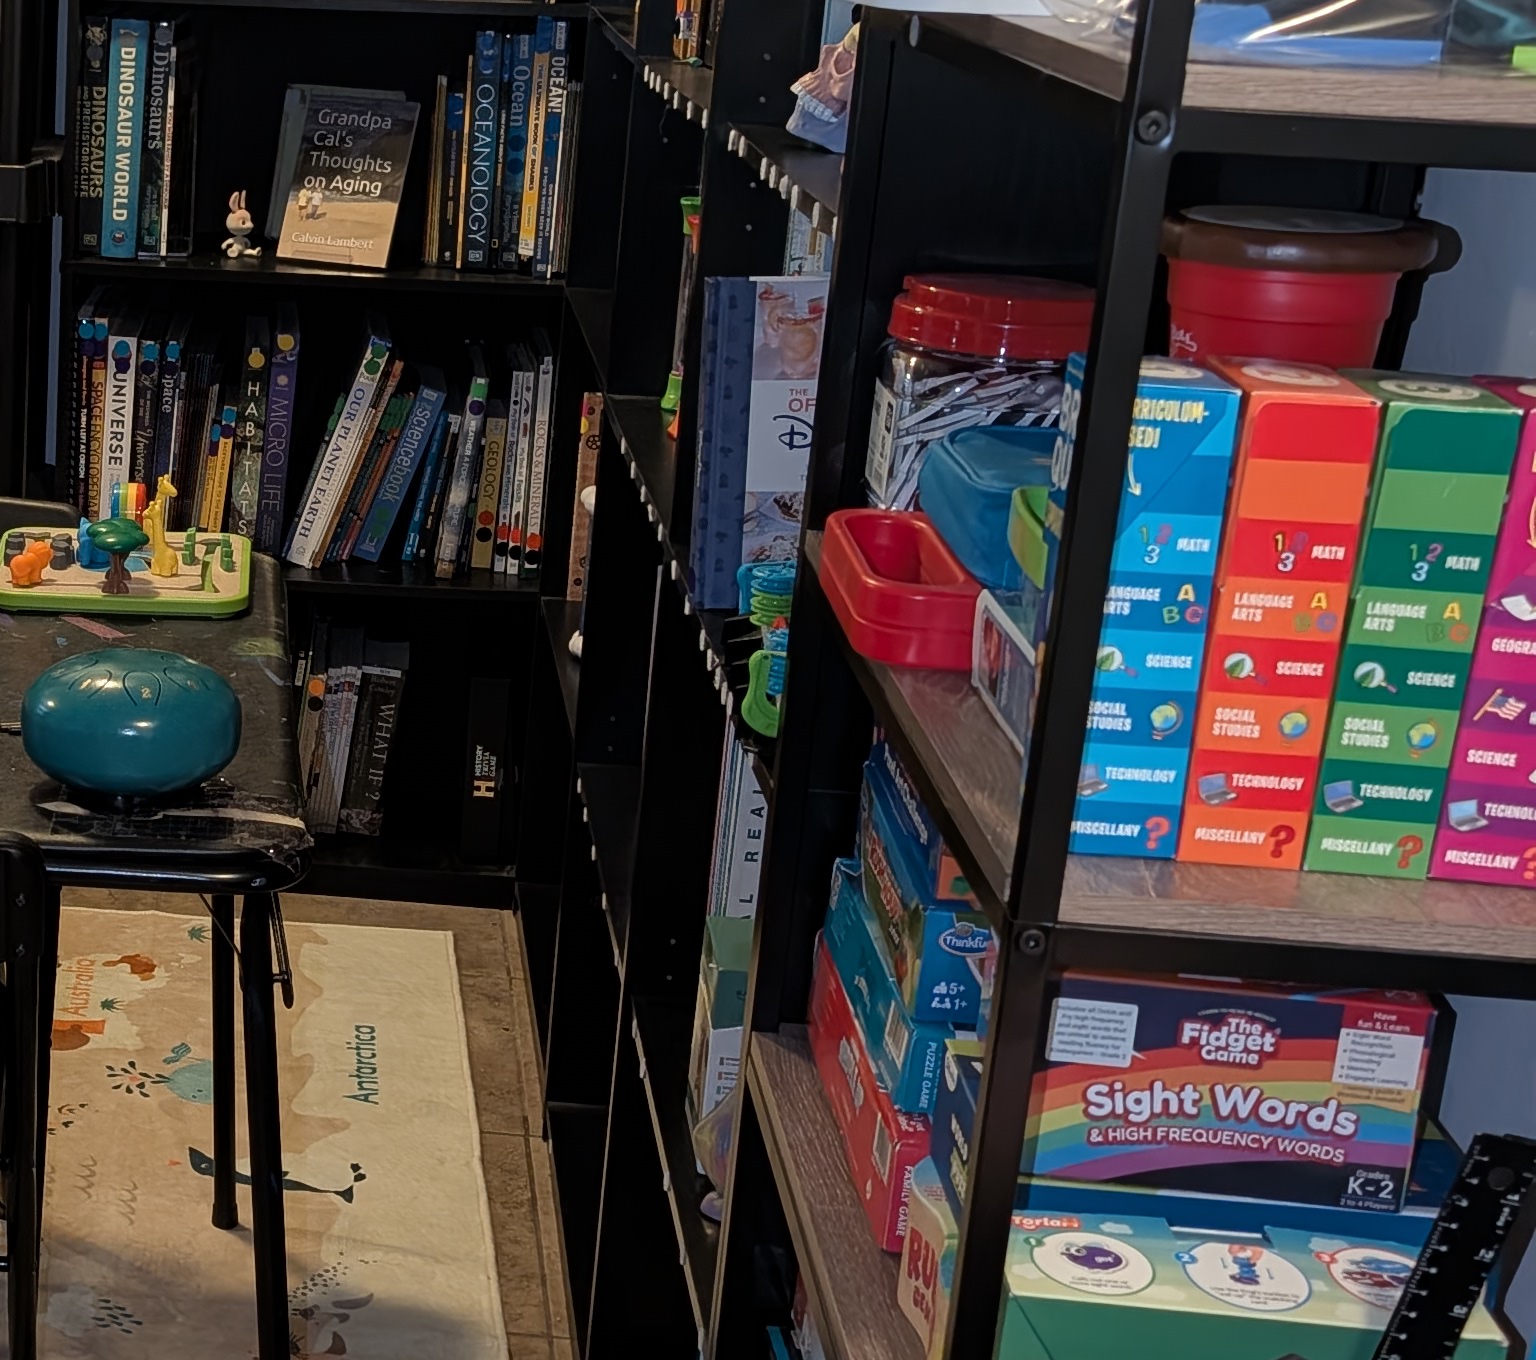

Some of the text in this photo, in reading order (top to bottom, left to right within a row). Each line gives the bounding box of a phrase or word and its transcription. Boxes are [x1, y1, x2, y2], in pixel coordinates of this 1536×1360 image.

[548, 56, 565, 113] OCEAN!
[148, 51, 170, 149] Dinosaurs
[510, 65, 530, 127] Ocean
[317, 108, 393, 131] Grandpa
[90, 86, 107, 199] DINOSAURS
[113, 47, 136, 221] DINOSAUR WORLD
[313, 129, 354, 148] Cal's
[310, 150, 392, 174] Thoughts
[468, 83, 495, 244] OCEANOLOGY
[303, 174, 382, 198] on Aging
[291, 231, 374, 251] Calvin Lambert
[108, 373, 128, 466] UNIVERSE
[261, 397, 288, 512] MICRO LIFE
[298, 388, 365, 539] OUR PLANET EARTH
[481, 440, 501, 501] GEOLOGY
[1176, 537, 1211, 553] MATH
[1311, 545, 1345, 562] MATH
[1445, 556, 1480, 573] MATH
[1234, 591, 1295, 609] LANGUAGE
[1231, 607, 1263, 624] ARTS
[1366, 601, 1428, 620] LANGUAGE
[1363, 615, 1395, 633] ARTS
[1145, 652, 1193, 670] SCIENCE
[1276, 661, 1324, 678] SCIENCE
[1406, 671, 1456, 689] SCIENCE
[1214, 706, 1256, 724] SOCIAL
[372, 703, 396, 764] WHAT
[1212, 721, 1260, 740] STUDIES
[1344, 717, 1386, 734] SOCIAL
[1341, 732, 1390, 750] STUDIES
[1466, 749, 1517, 768] SCIENCE
[1104, 766, 1177, 784] TECHNOLOGY
[1232, 772, 1305, 791] TECHNOLOGY
[1359, 782, 1433, 802] TECHNOLOGY
[1194, 827, 1265, 847] MISCELLANY
[1320, 836, 1393, 857] MISCELLANY
[1444, 850, 1518, 870] MISCELLANY
[68, 953, 95, 1019] Australia
[949, 983, 965, 994] 5+
[954, 999, 967, 1010] 1+
[1226, 1017, 1262, 1035] The
[1373, 1012, 1397, 1021] Have
[1181, 1021, 1277, 1055] Fidget
[343, 1022, 377, 1105] Antarctica
[1200, 1047, 1259, 1066] Game
[918, 1042, 938, 1110] PUZZLE GAME
[1085, 1083, 1200, 1122] Sight
[1210, 1084, 1358, 1136] Words
[1089, 1126, 1345, 1164] & HIGH FREQUENCY WORDS
[1356, 1169, 1391, 1180] Grades
[1347, 1177, 1394, 1199] K-2
